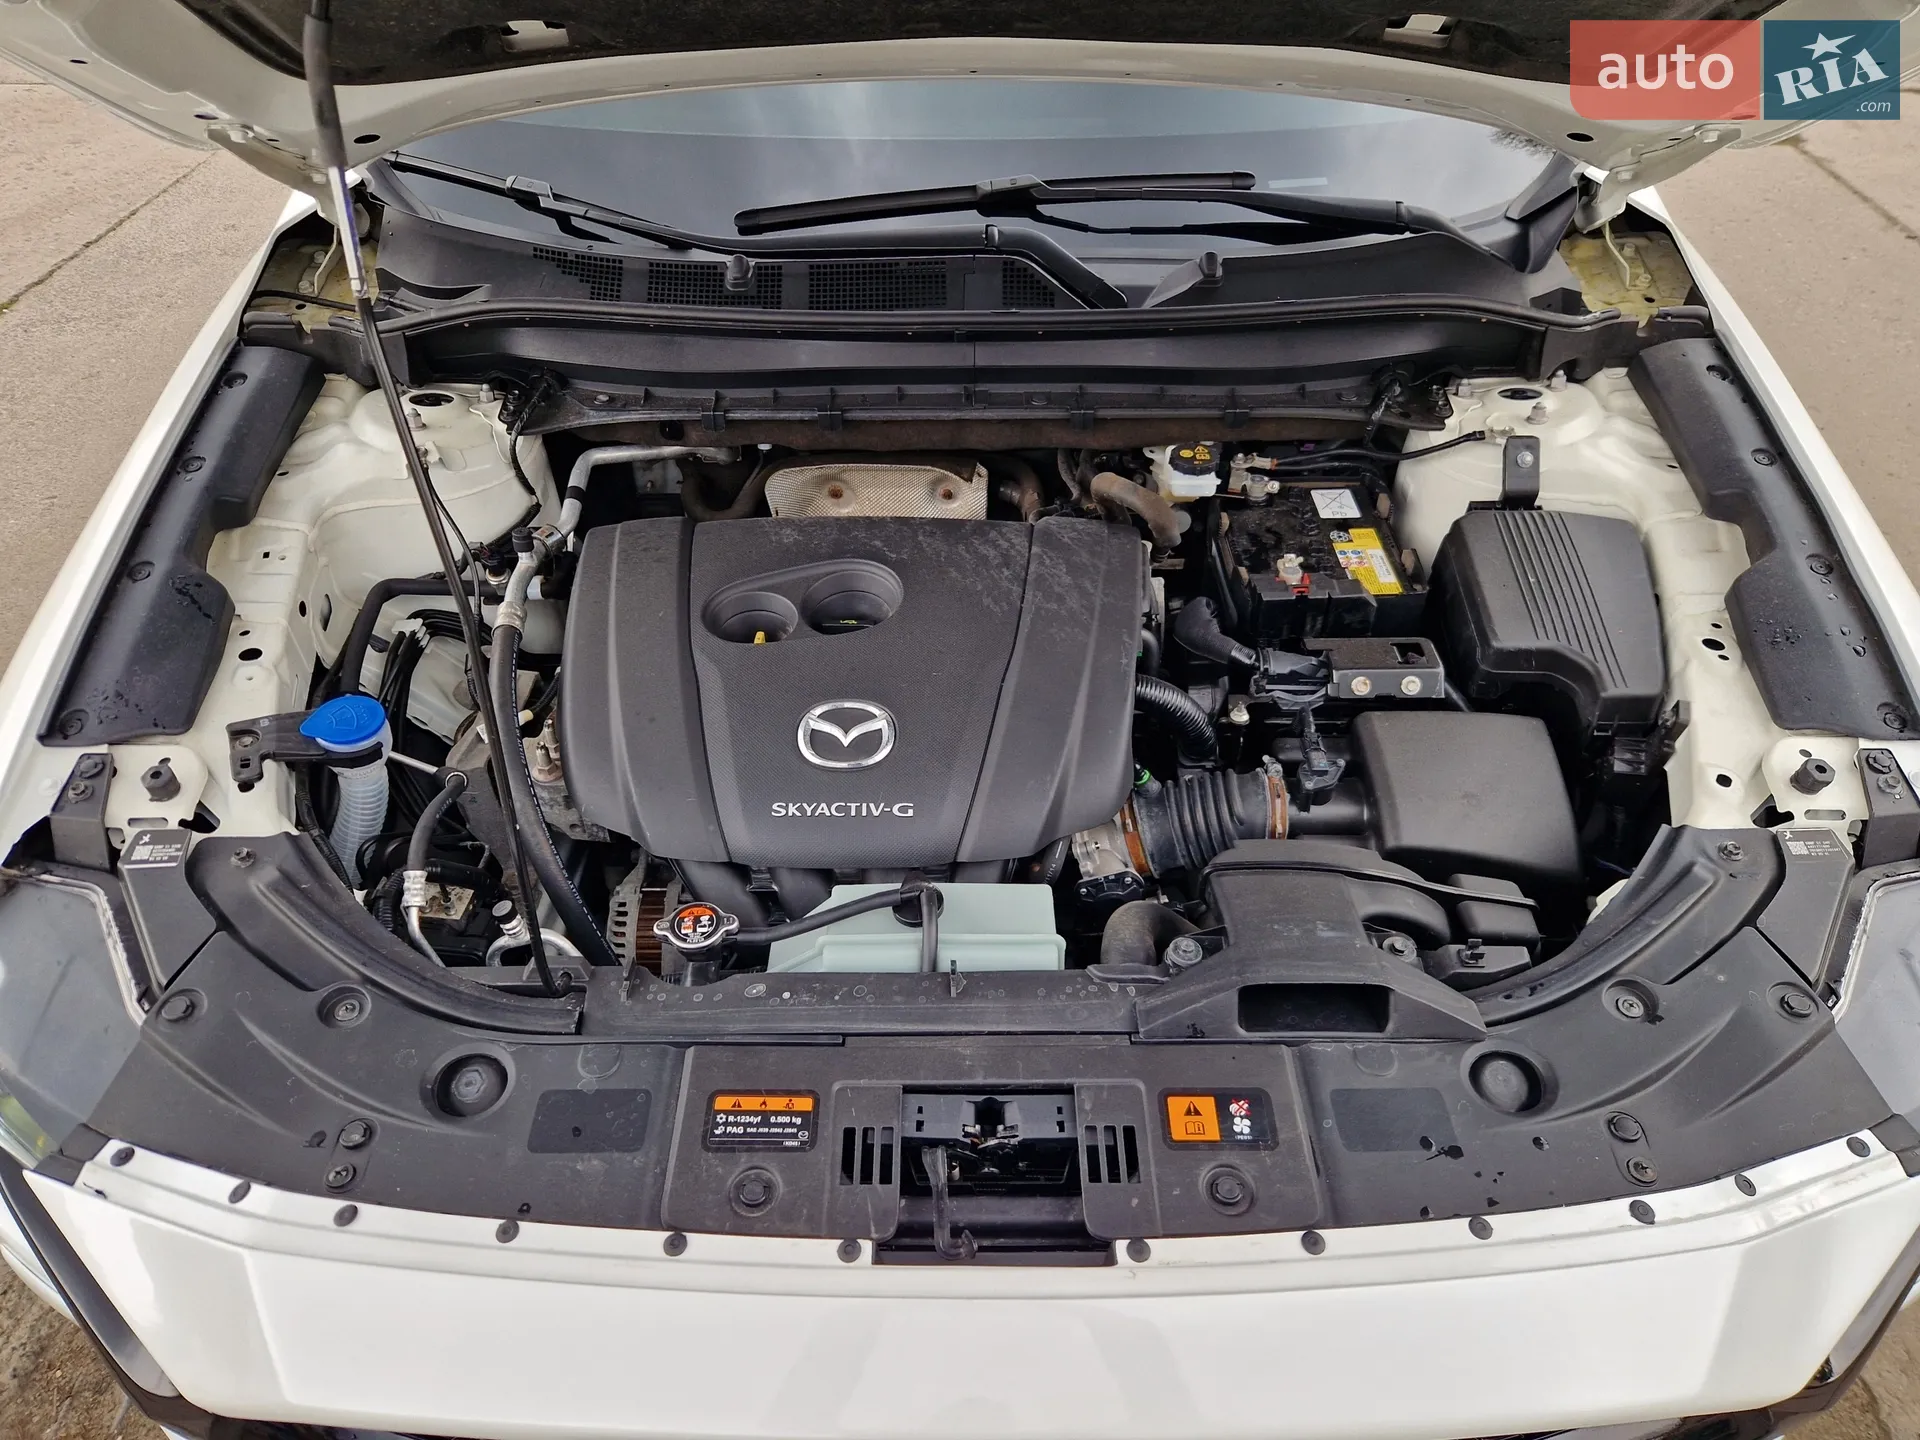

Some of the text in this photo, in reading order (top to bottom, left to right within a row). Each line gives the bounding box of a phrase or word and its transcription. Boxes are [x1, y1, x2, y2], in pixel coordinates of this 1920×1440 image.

[771, 802, 915, 817] SKYACTIV-G
[568, 880, 583, 904] GALAXY
[727, 1115, 802, 1125] R-1234yf 0.500 kg
[726, 1126, 744, 1134] PAG
